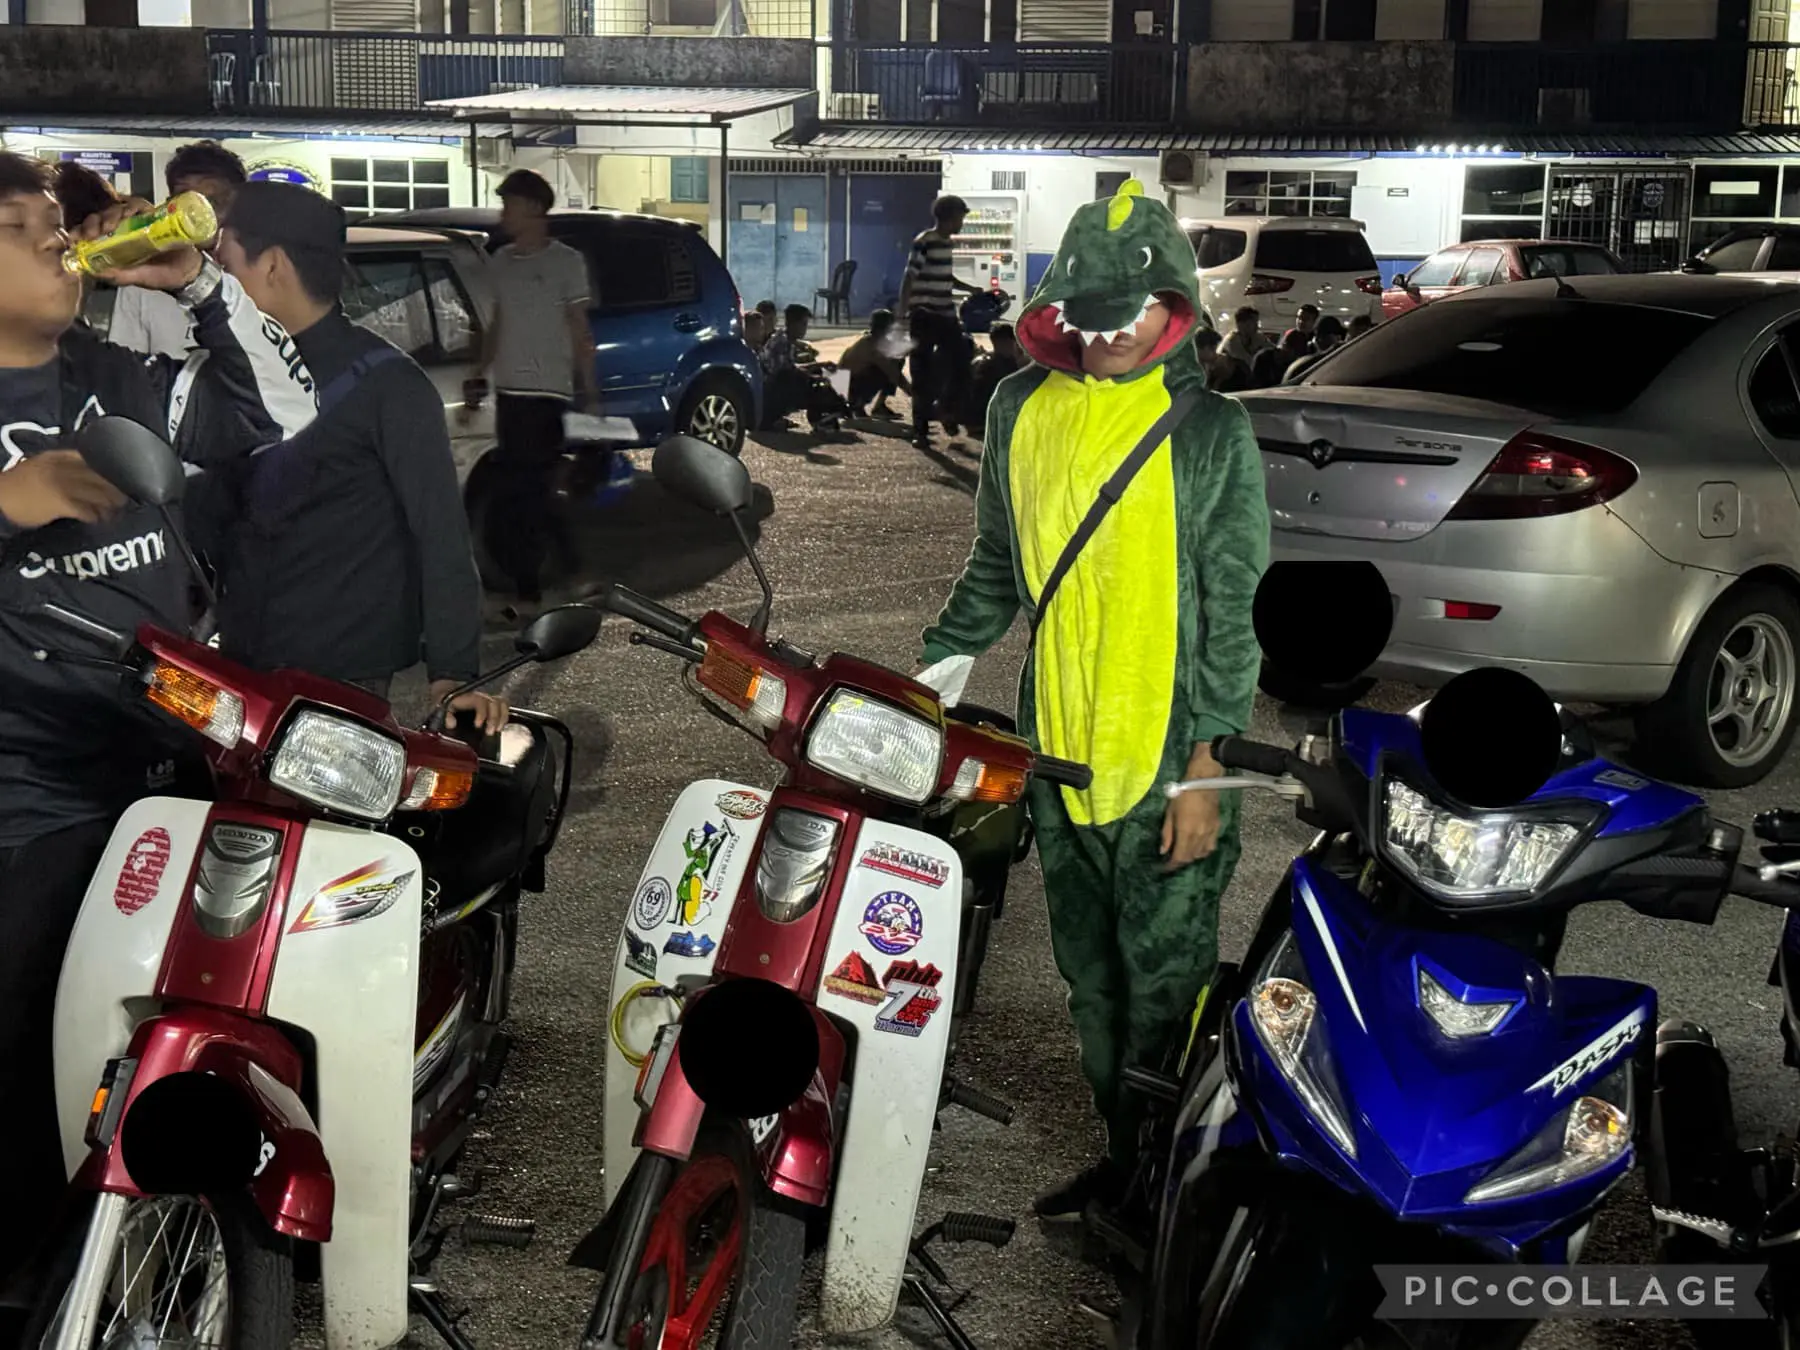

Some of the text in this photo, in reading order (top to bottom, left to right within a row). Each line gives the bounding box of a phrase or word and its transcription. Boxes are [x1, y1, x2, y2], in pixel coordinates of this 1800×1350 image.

[1395, 436, 1462, 452] Persona
[216, 827, 268, 844] HONDA
[647, 890, 661, 906] 69
[880, 892, 916, 911] TEAM
